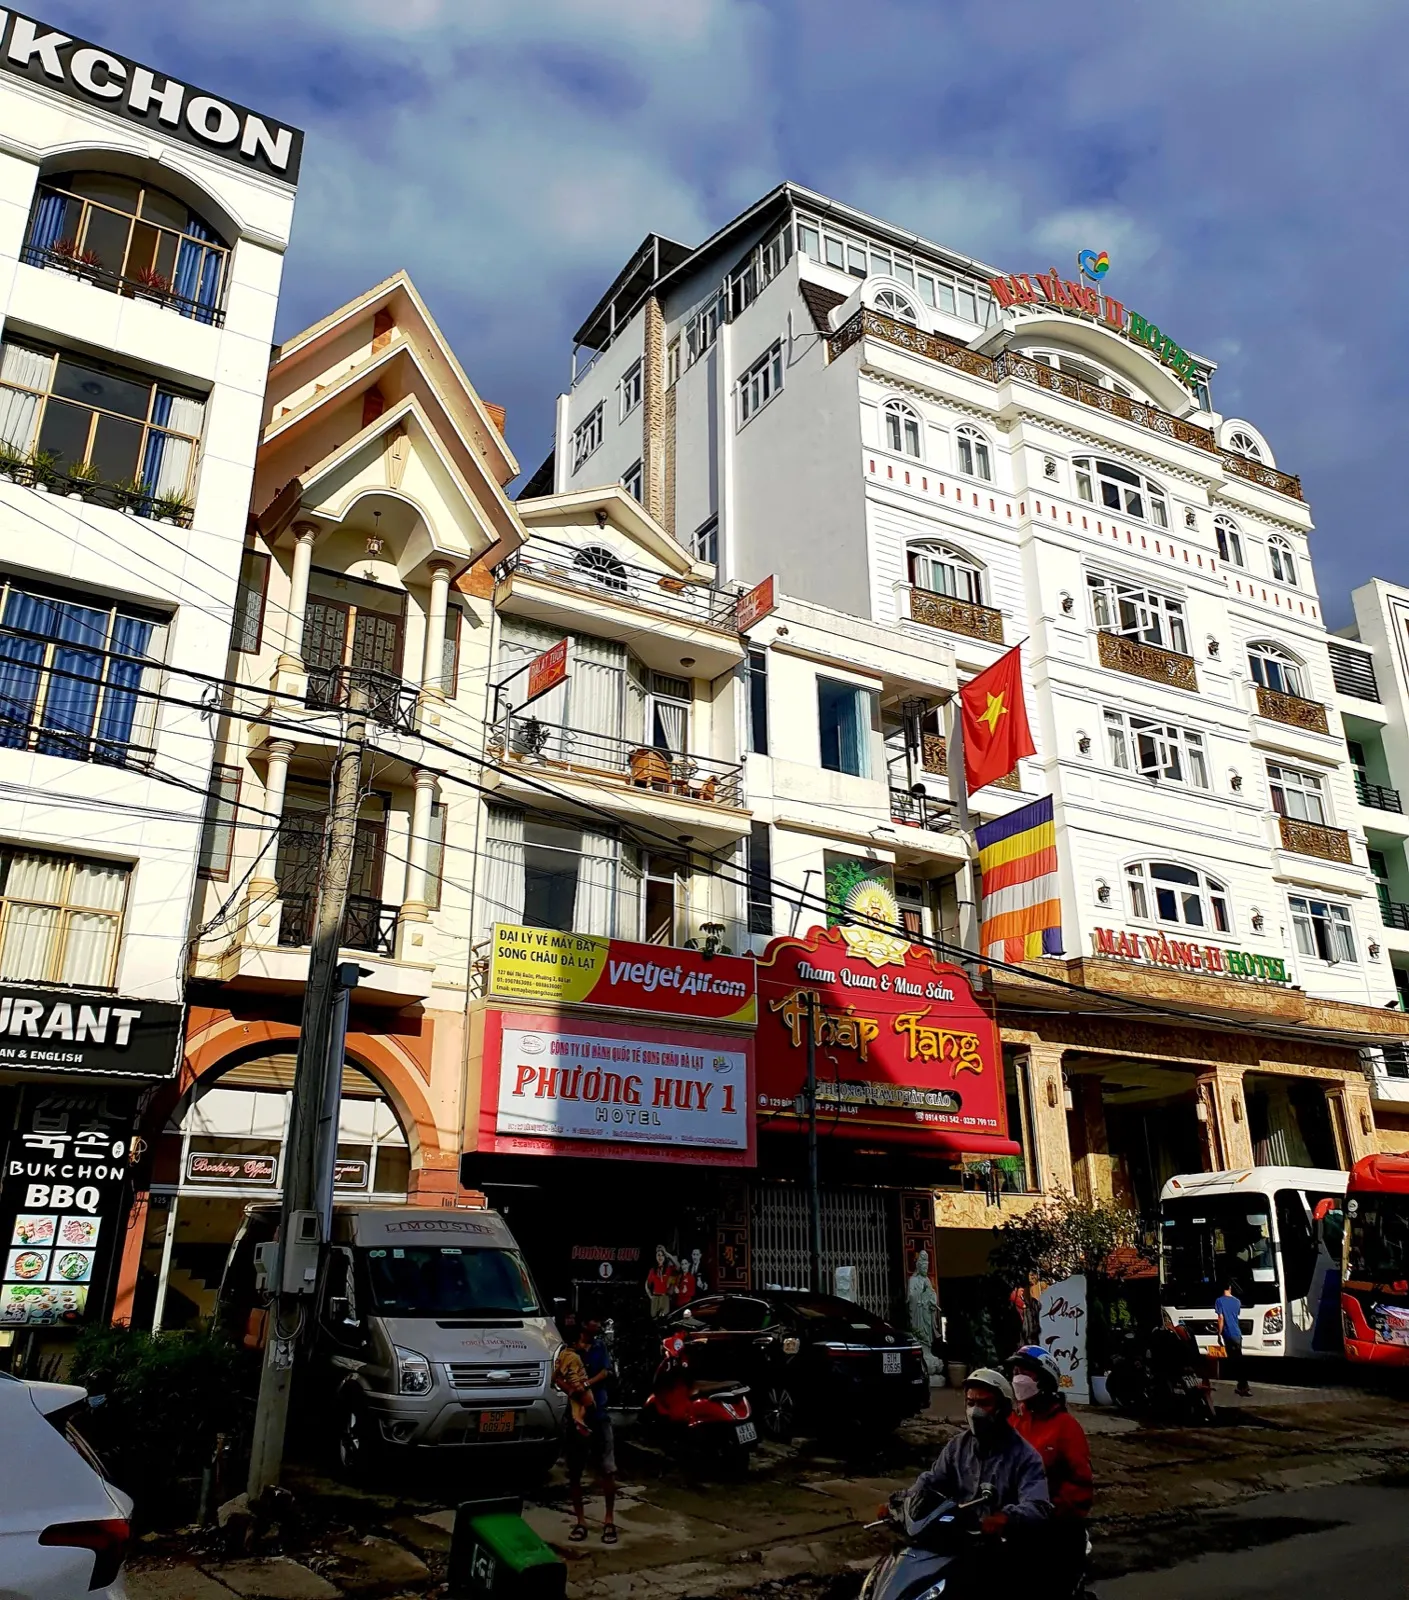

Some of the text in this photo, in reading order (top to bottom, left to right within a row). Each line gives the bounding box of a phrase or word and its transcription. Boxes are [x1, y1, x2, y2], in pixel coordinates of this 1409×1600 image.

[0, 10, 293, 170] KCHON
[988, 267, 1203, 388] MAI VÀNG II HOTEL
[500, 930, 597, 952] ĐẠI LÝ VÉ MÁY BAY
[1094, 927, 1292, 983] MAI VÀNG II HOTEL
[498, 946, 595, 971] SONG CHÂU ĐÀ LẠT
[609, 959, 682, 991] Vietjet
[798, 961, 955, 1001] Tham Quan & Mua Sắm
[895, 1005, 984, 1075] Tạng
[17, 1049, 28, 1059] &
[30, 1051, 83, 1063] ENGLISH
[550, 1040, 569, 1055] CÔNG
[571, 1043, 580, 1057] TY
[612, 1045, 631, 1062] QUỐC
[632, 1046, 641, 1063] TẾ
[691, 1055, 704, 1071] LẠT
[512, 1064, 738, 1113] PHƯƠNG HUY 1
[769, 1098, 781, 1107] 129
[925, 1092, 951, 1107] GIÁO
[595, 1107, 661, 1126] HOTEL
[22, 1109, 111, 1160] 북촌
[9, 1160, 125, 1181] BUKCHON
[192, 1158, 241, 1178] Booking
[24, 1184, 101, 1214] BBQ
[385, 1220, 495, 1235] LIMOUSINE
